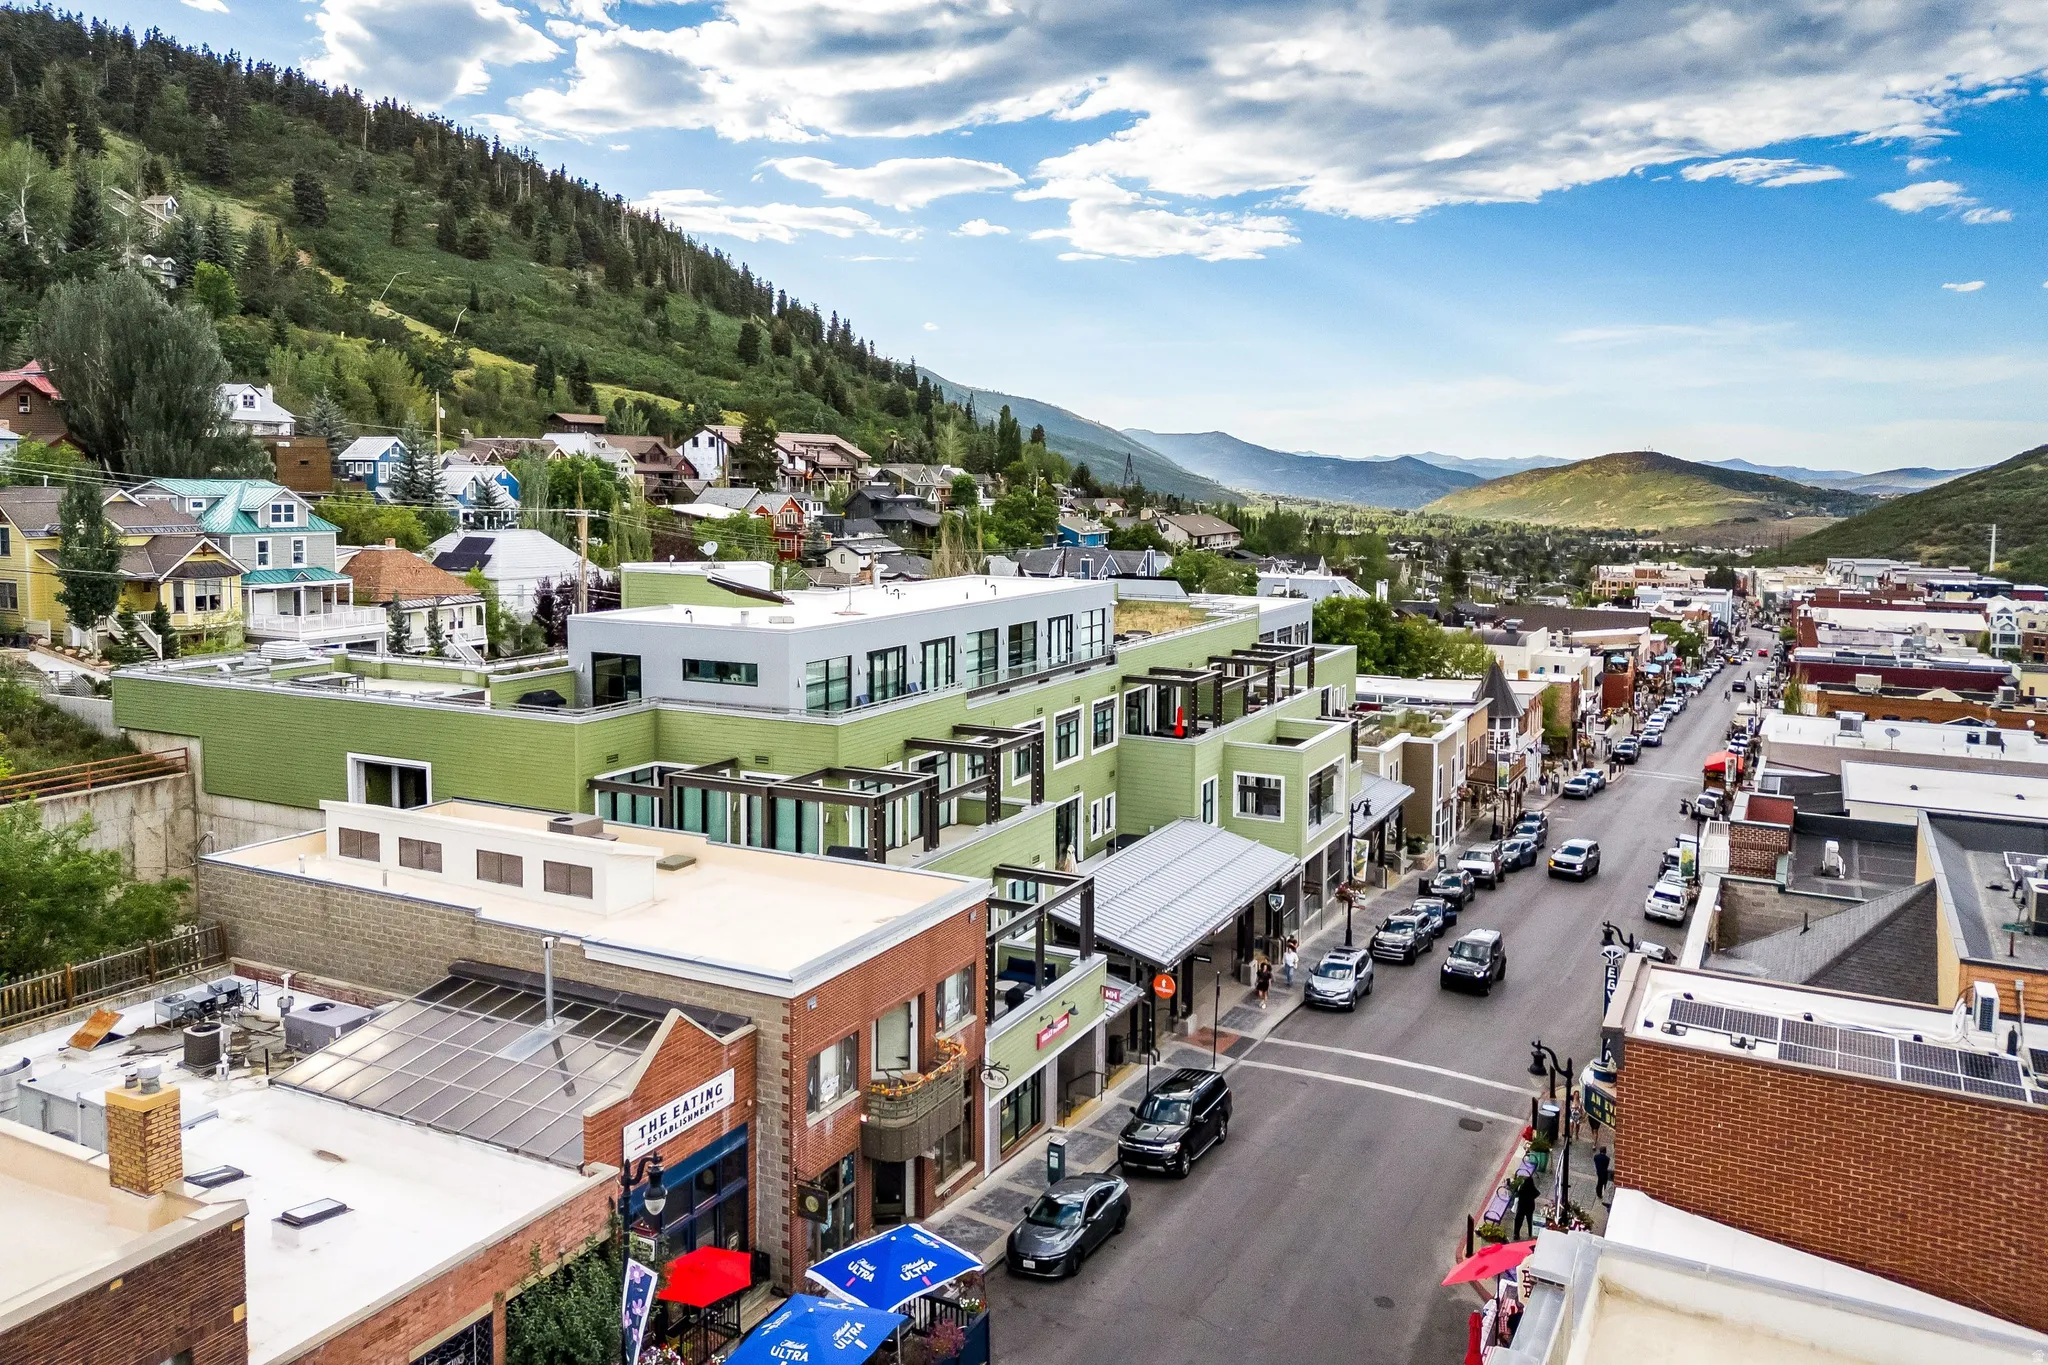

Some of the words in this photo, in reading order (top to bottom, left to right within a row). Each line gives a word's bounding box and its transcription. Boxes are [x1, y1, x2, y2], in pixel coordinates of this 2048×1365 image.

[1105, 990, 1118, 1000] HH
[638, 1112, 667, 1139] THE
[673, 1083, 723, 1119] EATING
[647, 1101, 715, 1146] ESTABLISHMENT
[848, 1260, 875, 1282] ULTRA
[900, 1260, 938, 1281] ULTRA
[834, 1322, 866, 1350] ULTRA
[770, 1345, 809, 1362] ULTRA
